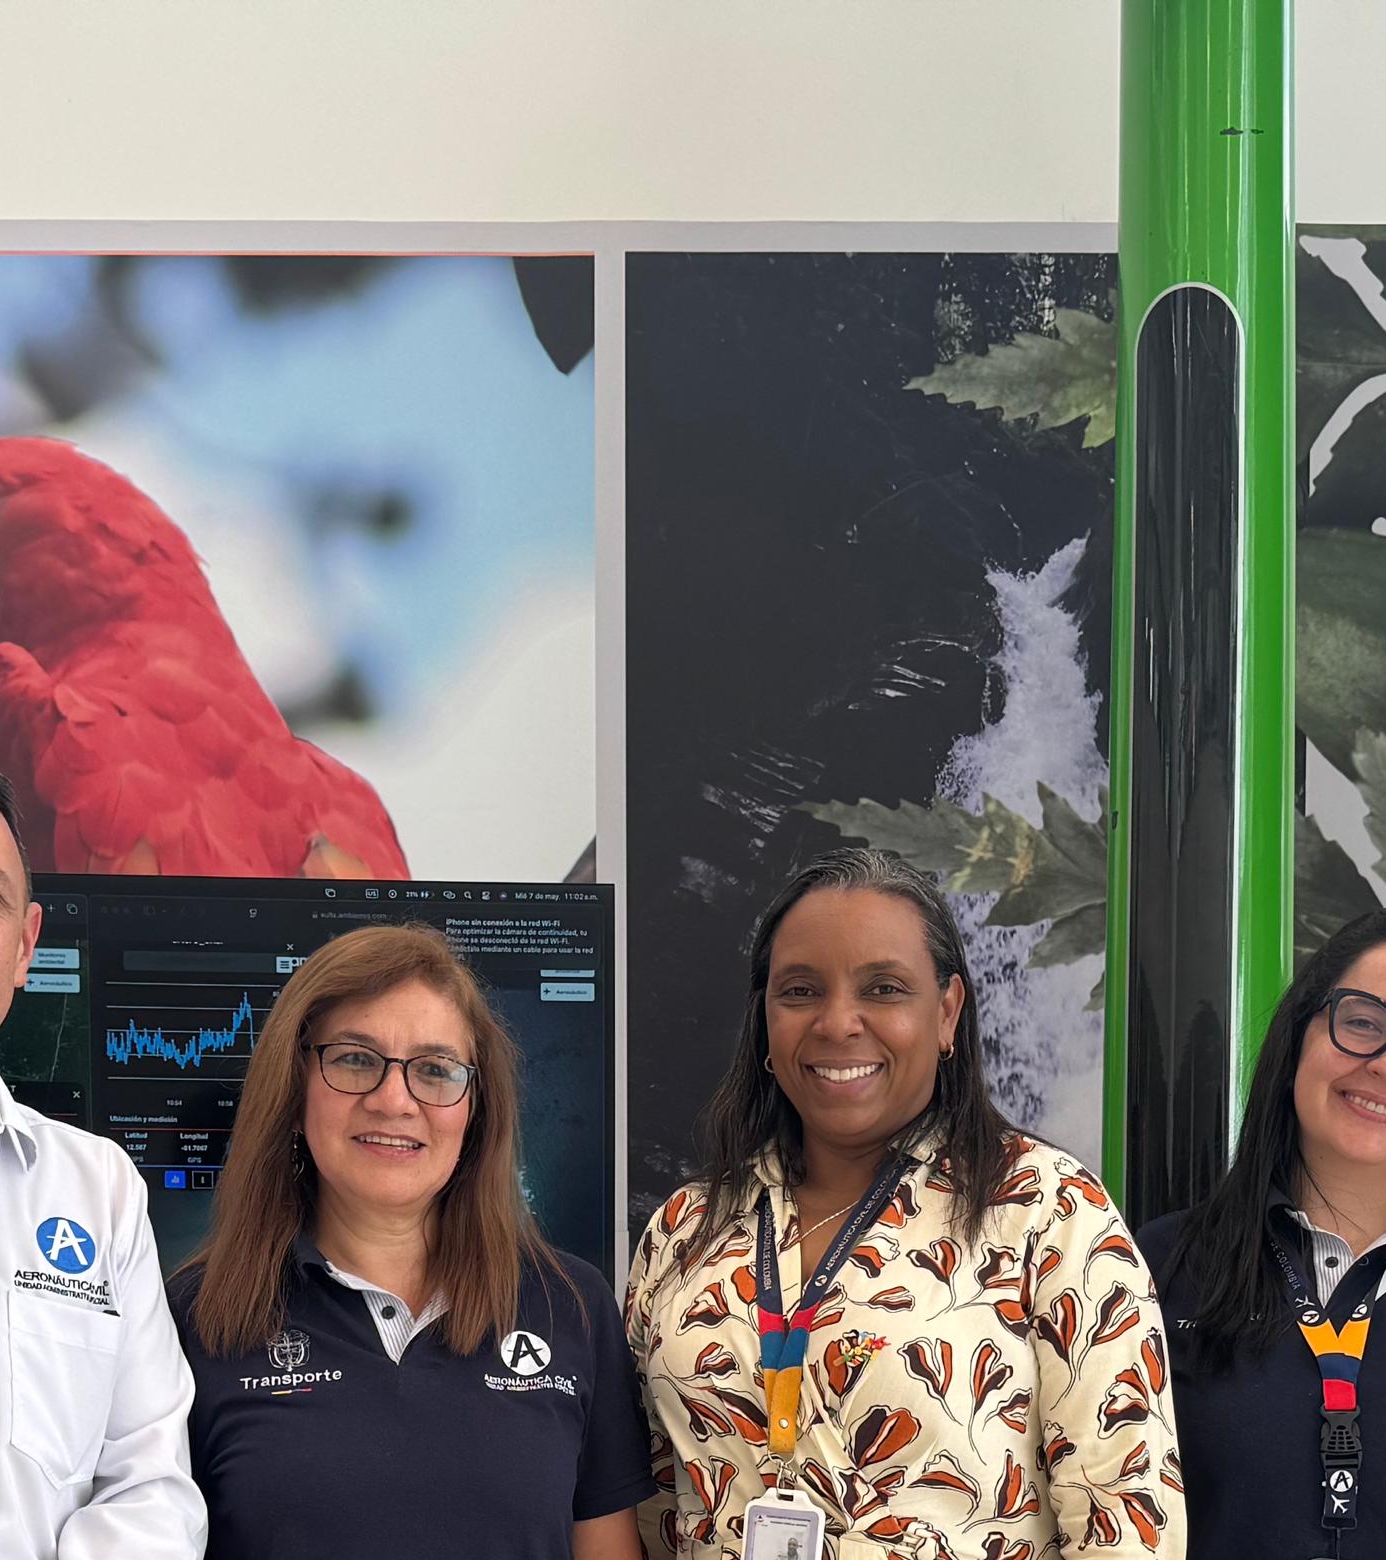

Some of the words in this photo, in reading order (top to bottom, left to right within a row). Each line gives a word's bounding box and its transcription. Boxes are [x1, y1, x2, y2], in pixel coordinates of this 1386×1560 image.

[528, 892, 534, 900] 7
[462, 928, 494, 937] optimizar
[180, 1132, 209, 1141] Longitud
[240, 1369, 342, 1390] Transporte
